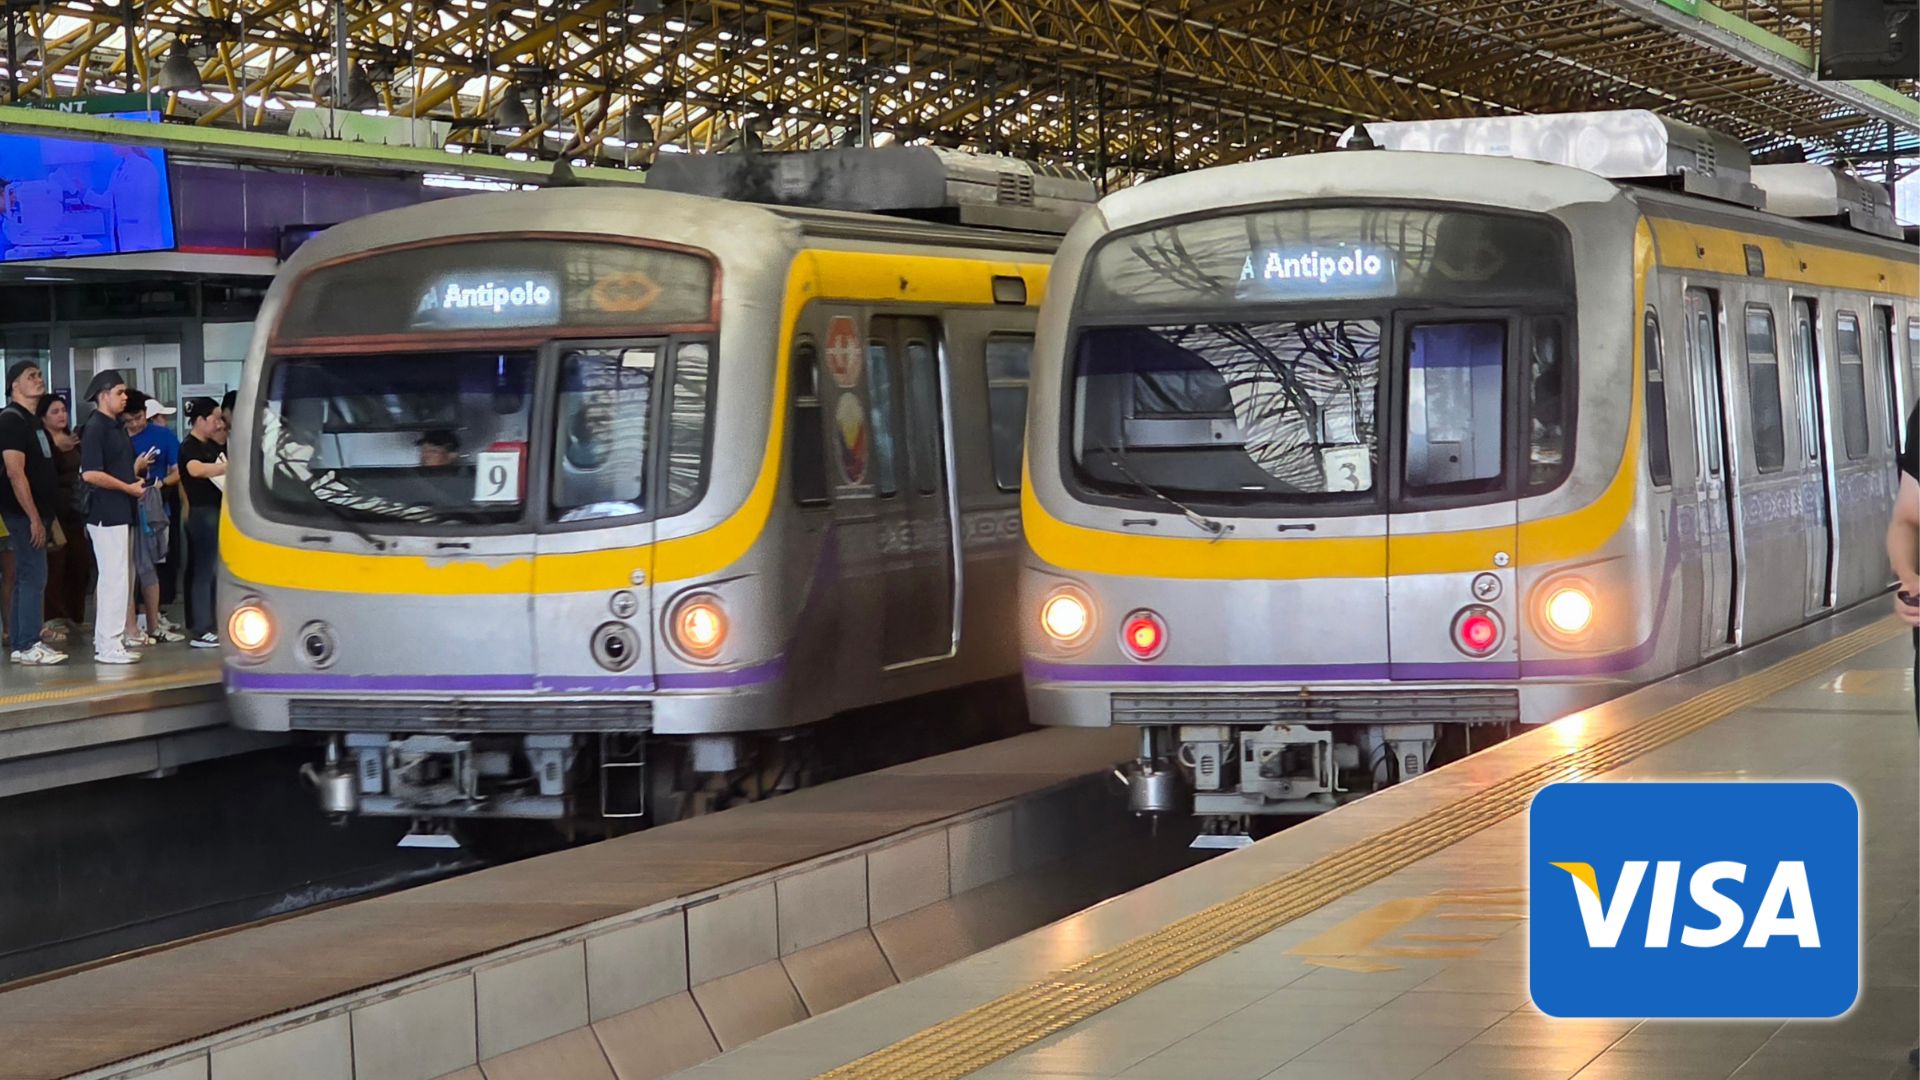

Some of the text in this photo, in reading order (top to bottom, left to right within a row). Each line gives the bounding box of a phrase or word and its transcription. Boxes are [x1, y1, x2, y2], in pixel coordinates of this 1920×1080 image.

[1240, 249, 1382, 283] A Antipolo
[443, 280, 551, 312] Antipolo
[487, 465, 507, 497] 9
[1339, 462, 1360, 491] 3
